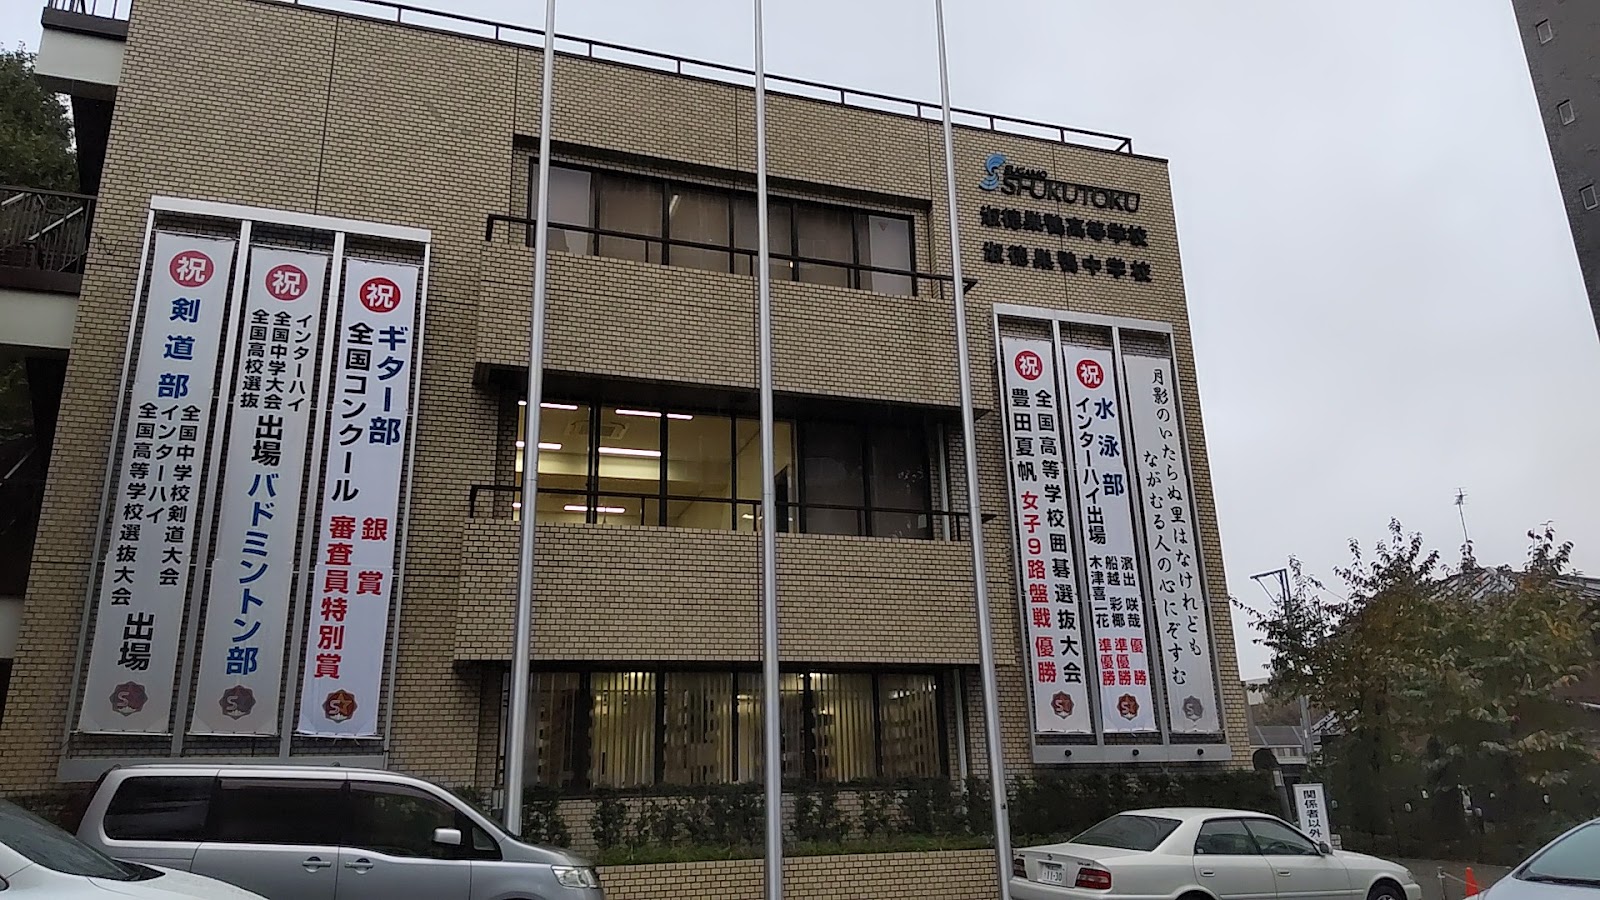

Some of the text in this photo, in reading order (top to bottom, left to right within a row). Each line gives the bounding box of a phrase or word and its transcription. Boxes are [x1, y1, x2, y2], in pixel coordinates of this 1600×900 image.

[1001, 175, 1141, 213] SHUKUTOKU
[1003, 164, 1048, 180] SUGAMO
[177, 256, 206, 282] 祝
[271, 269, 301, 297] 祝
[365, 283, 394, 309] 祝
[157, 297, 201, 399] 剣道部
[240, 309, 270, 409] 全国高校選抜
[263, 311, 292, 411] 全国中学大会
[287, 314, 312, 412] インターハイ
[368, 326, 408, 446] ギター部
[1019, 355, 1039, 377] 祝
[1080, 364, 1101, 385] 祝
[331, 322, 374, 503] 全国コンクール
[1094, 398, 1125, 496] 水泳部
[111, 403, 159, 606] 全国高等学校選抜大会
[145, 404, 179, 524] インターハイ
[159, 404, 201, 586] 全国中学校剣道大会
[1152, 368, 1201, 656] 月影のいたらぬ里はなけれども
[225, 473, 277, 676] バドミントン部
[1035, 389, 1082, 684] 全国高等学校囲碁選抜大会
[1143, 451, 1187, 686] ながむる人の心にぞすむ
[117, 612, 154, 671] 出場
[314, 515, 356, 680] 審査員特別賞
[1303, 789, 1322, 838] 関係者以外
